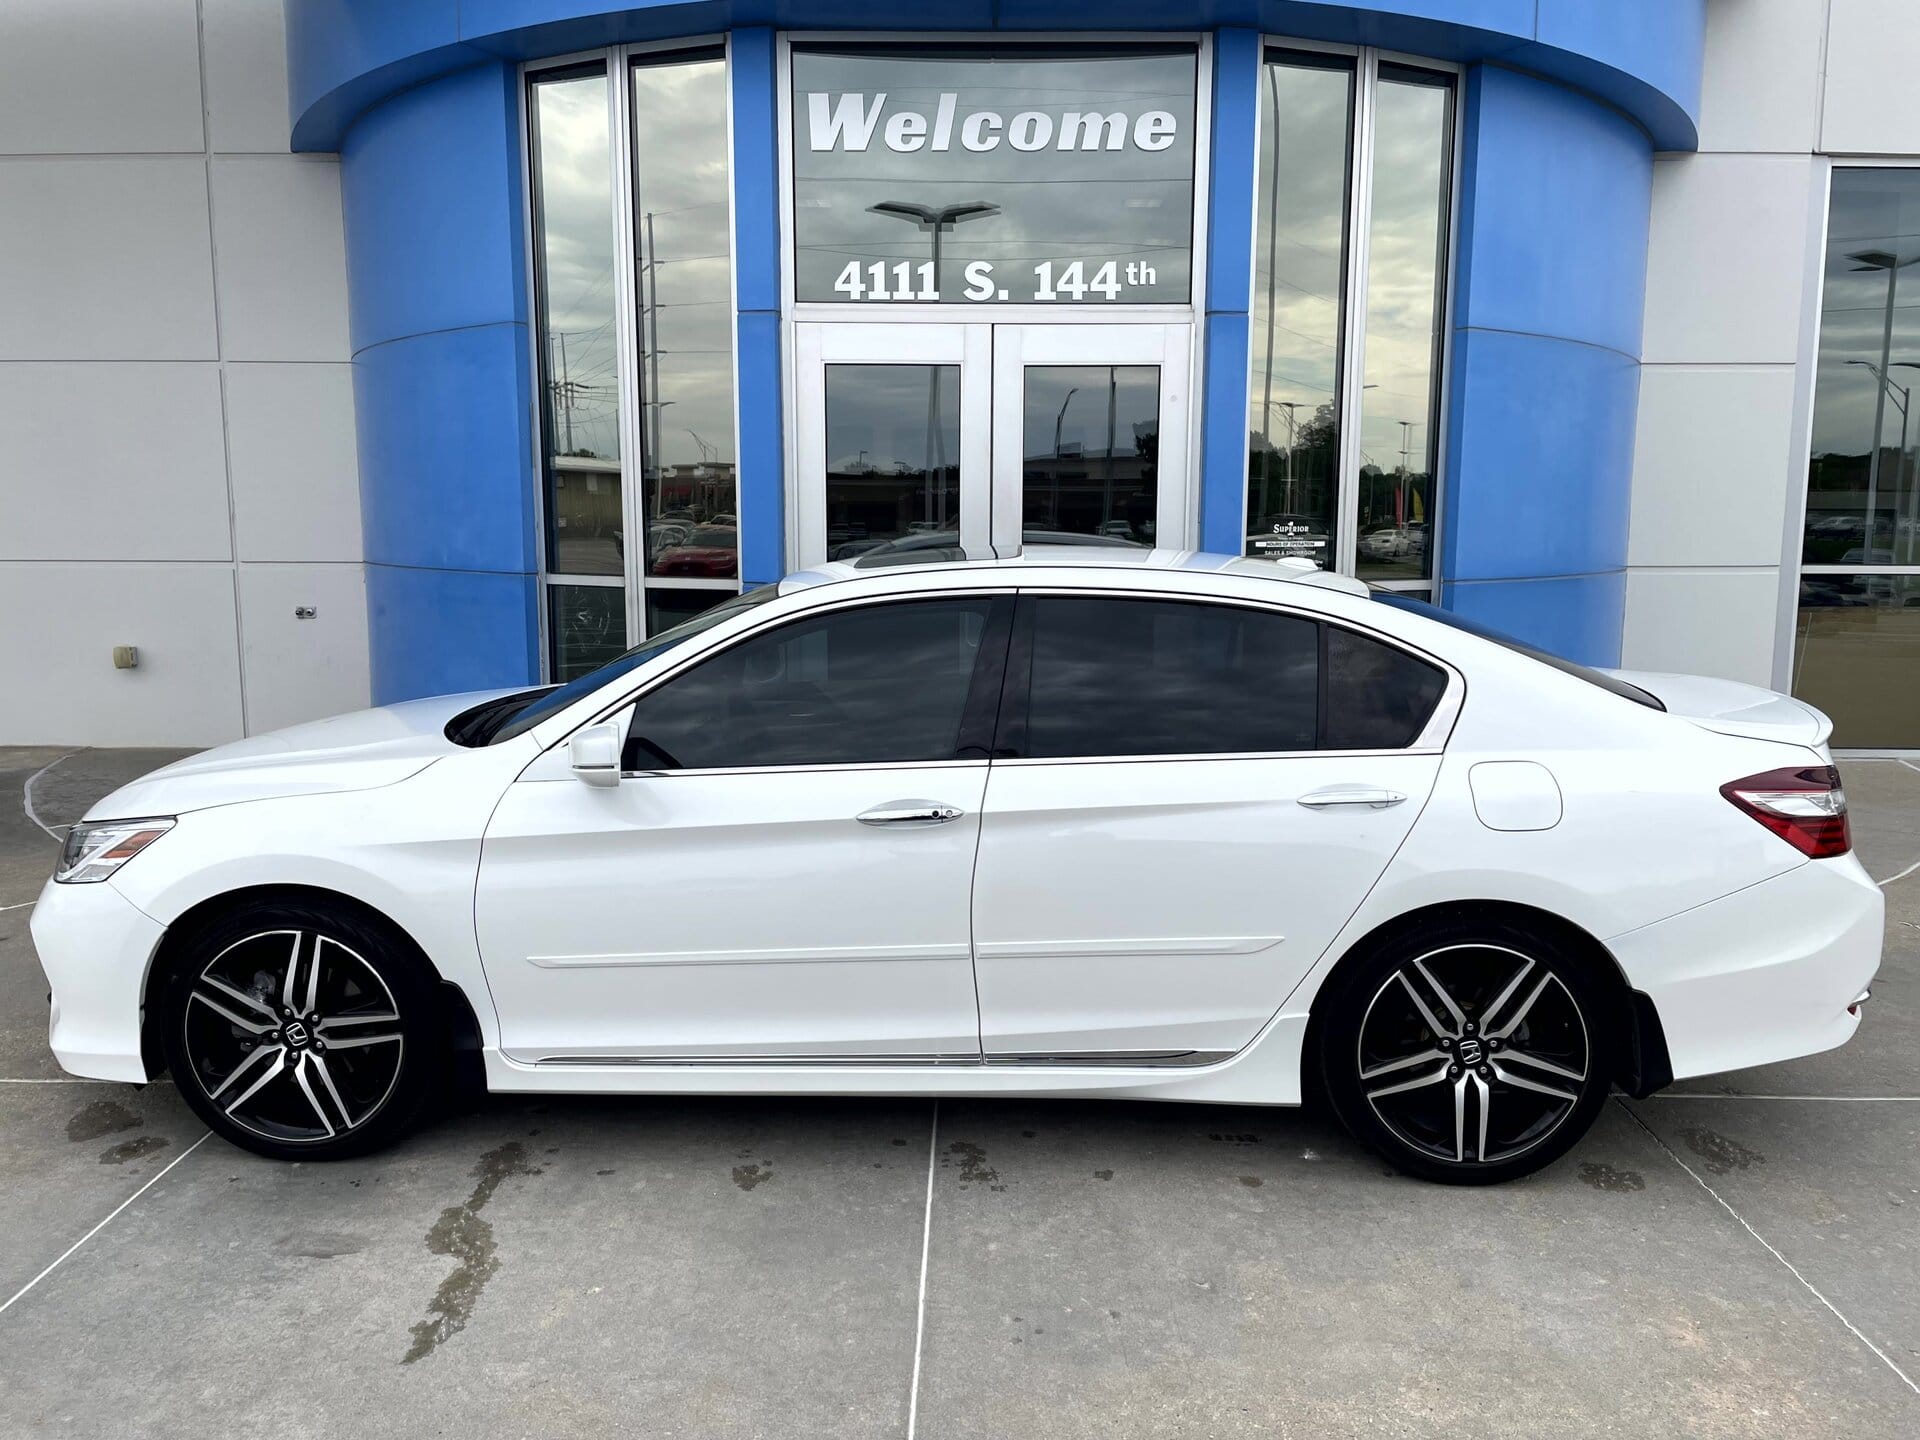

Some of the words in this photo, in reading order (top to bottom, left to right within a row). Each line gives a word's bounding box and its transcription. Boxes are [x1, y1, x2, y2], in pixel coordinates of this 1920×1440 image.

[807, 92, 1177, 152] Welcome
[834, 260, 940, 300] 4111
[963, 260, 1009, 301] S.
[1034, 260, 1156, 300] 144th
